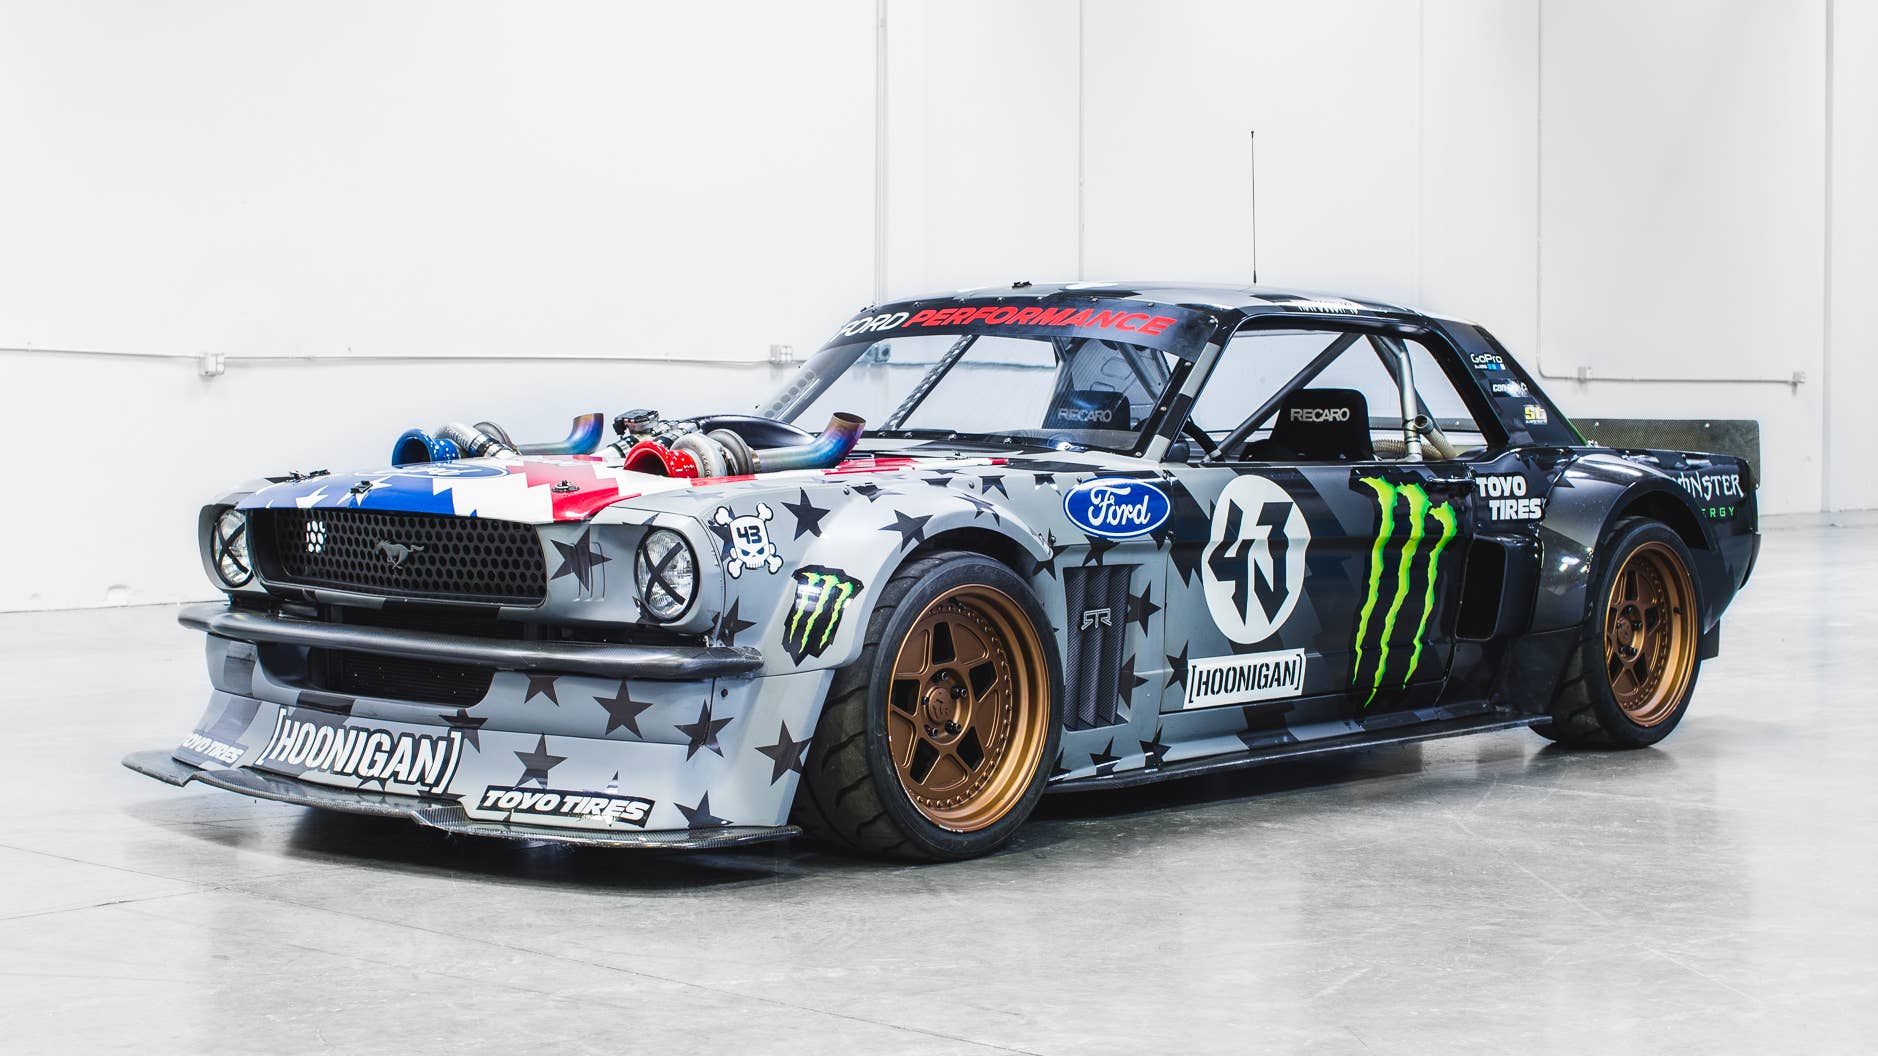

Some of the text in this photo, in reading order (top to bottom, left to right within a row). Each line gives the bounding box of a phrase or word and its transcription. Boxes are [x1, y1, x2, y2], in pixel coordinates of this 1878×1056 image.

[902, 305, 1177, 336] PERFORMANCE
[1470, 353, 1503, 364] GoPro
[1058, 407, 1112, 422] RECARO
[1290, 407, 1350, 422] RECARO
[1475, 475, 1527, 497] TOYO
[1087, 486, 1151, 526] Ford
[1489, 497, 1542, 520] TIRES
[736, 525, 763, 544] 43
[1207, 498, 1294, 627] 43
[182, 733, 213, 752] OYO
[483, 790, 650, 821] TOYO TIRES
